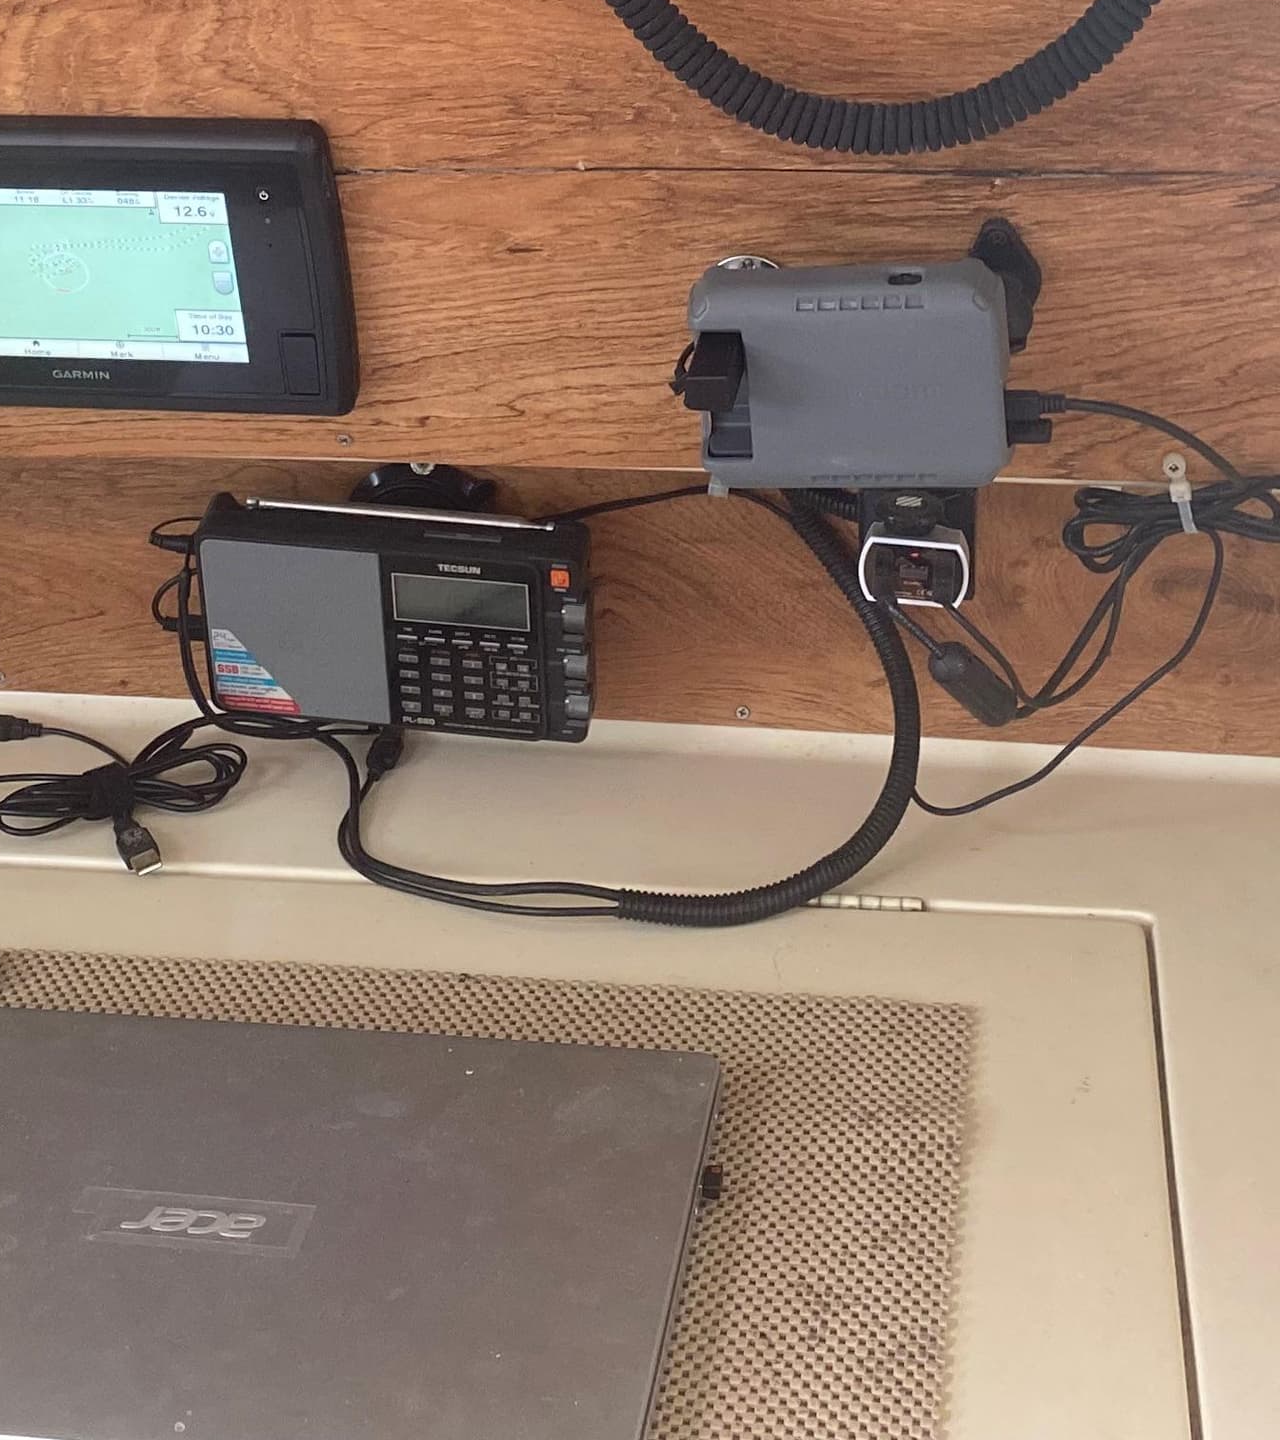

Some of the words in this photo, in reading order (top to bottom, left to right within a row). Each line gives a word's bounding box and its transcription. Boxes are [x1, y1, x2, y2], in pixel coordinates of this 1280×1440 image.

[174, 206, 207, 218] 12.6
[192, 324, 234, 336] 10:30
[194, 352, 220, 360] Menu
[52, 369, 110, 381] GARMIN
[437, 563, 480, 575] TECSUN
[120, 1206, 266, 1238] acer
